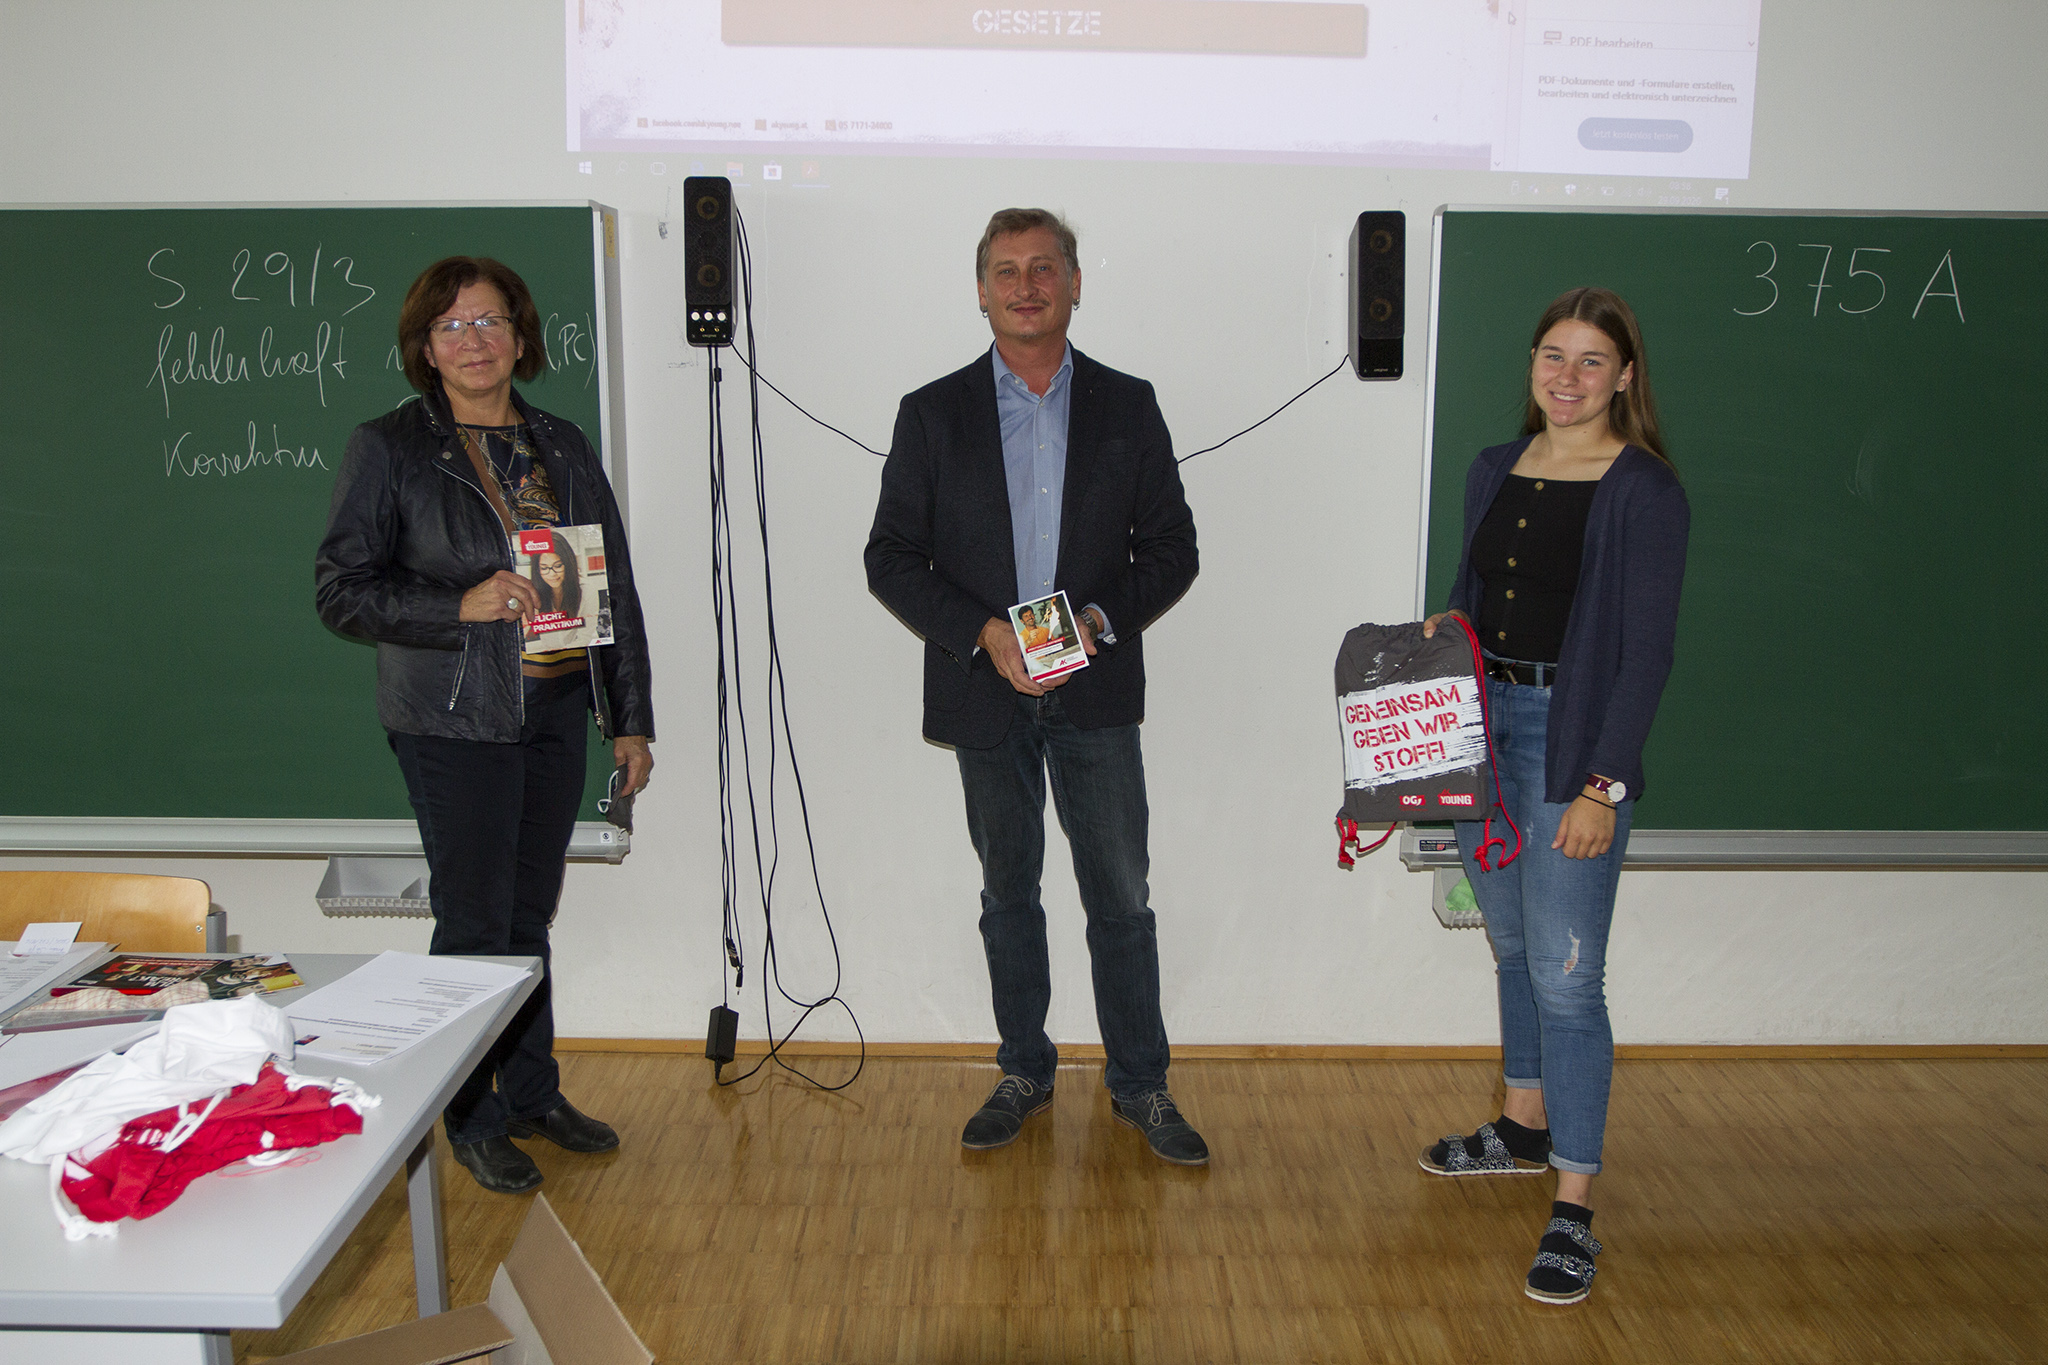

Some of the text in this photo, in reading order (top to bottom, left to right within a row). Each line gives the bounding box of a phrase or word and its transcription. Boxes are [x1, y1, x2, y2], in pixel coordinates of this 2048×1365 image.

[972, 9, 1101, 35] GESETZE
[1570, 36, 1653, 49] PDF bearbeiten
[1538, 75, 1736, 92] PDF-Dokumente und -Formulare erstellen,
[1538, 89, 1737, 104] bearbeiten und elektronisch unterzeichnen
[838, 120, 848, 130] 05
[529, 612, 566, 625] FLICHT-
[533, 618, 583, 633] PRAKTIKUM
[1414, 711, 1462, 737] WIR
[1373, 740, 1447, 773] STOFF!
[1440, 795, 1473, 805] YOUNG
